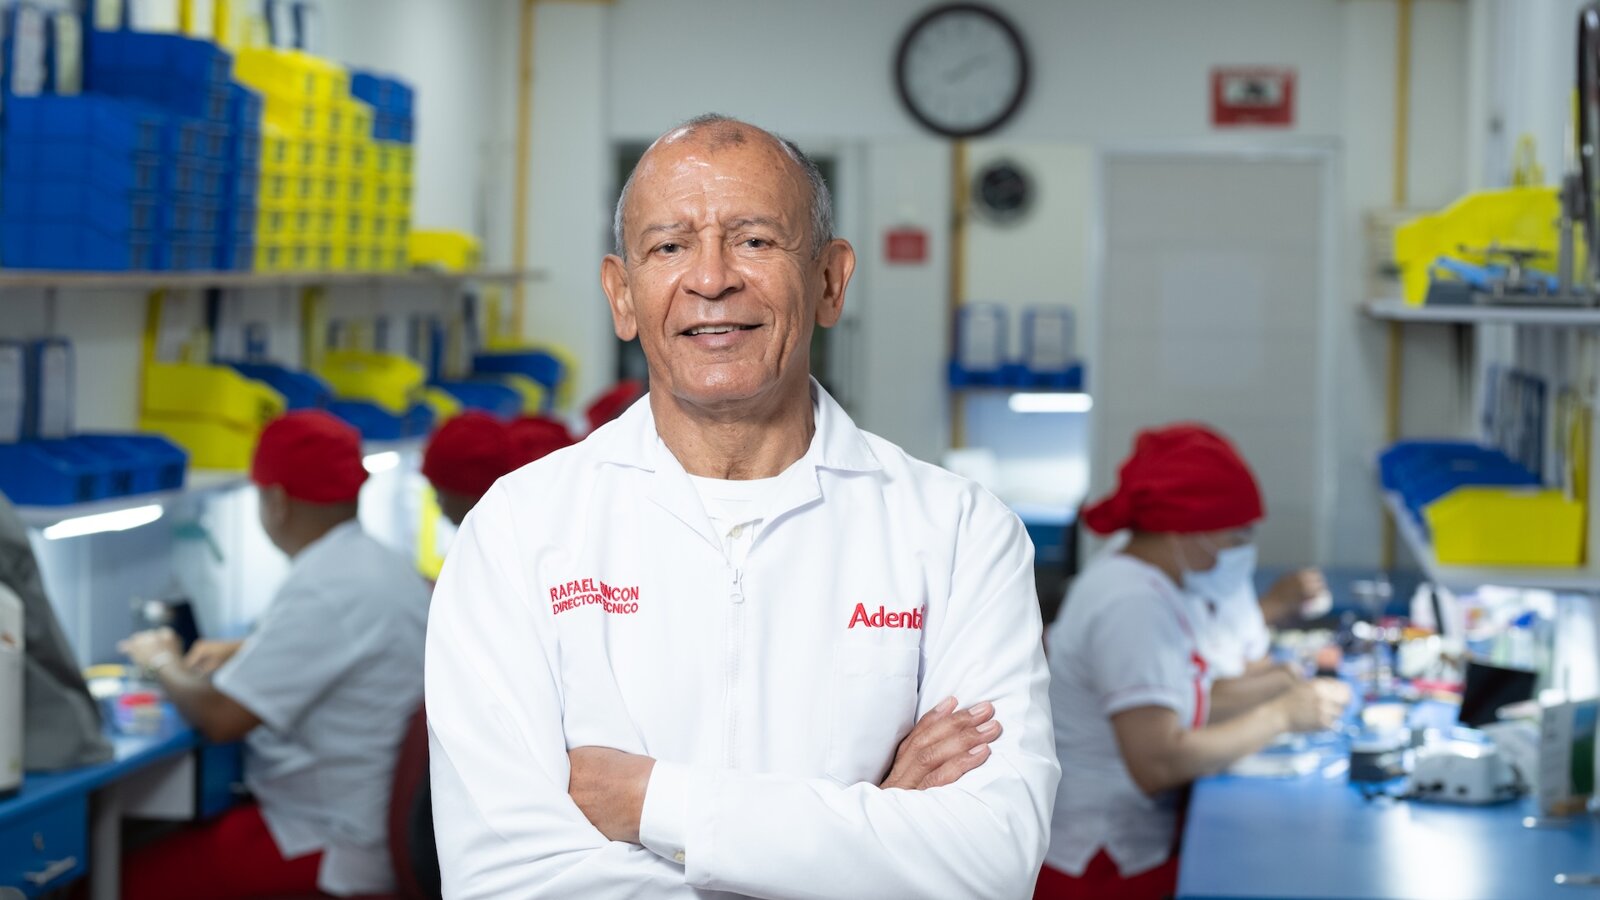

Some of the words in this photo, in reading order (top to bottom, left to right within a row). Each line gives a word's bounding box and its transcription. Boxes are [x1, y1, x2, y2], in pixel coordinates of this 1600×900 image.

[549, 578, 598, 602] RAFAEL
[553, 593, 602, 615] DIRECTOR
[602, 598, 638, 614] ECNICO
